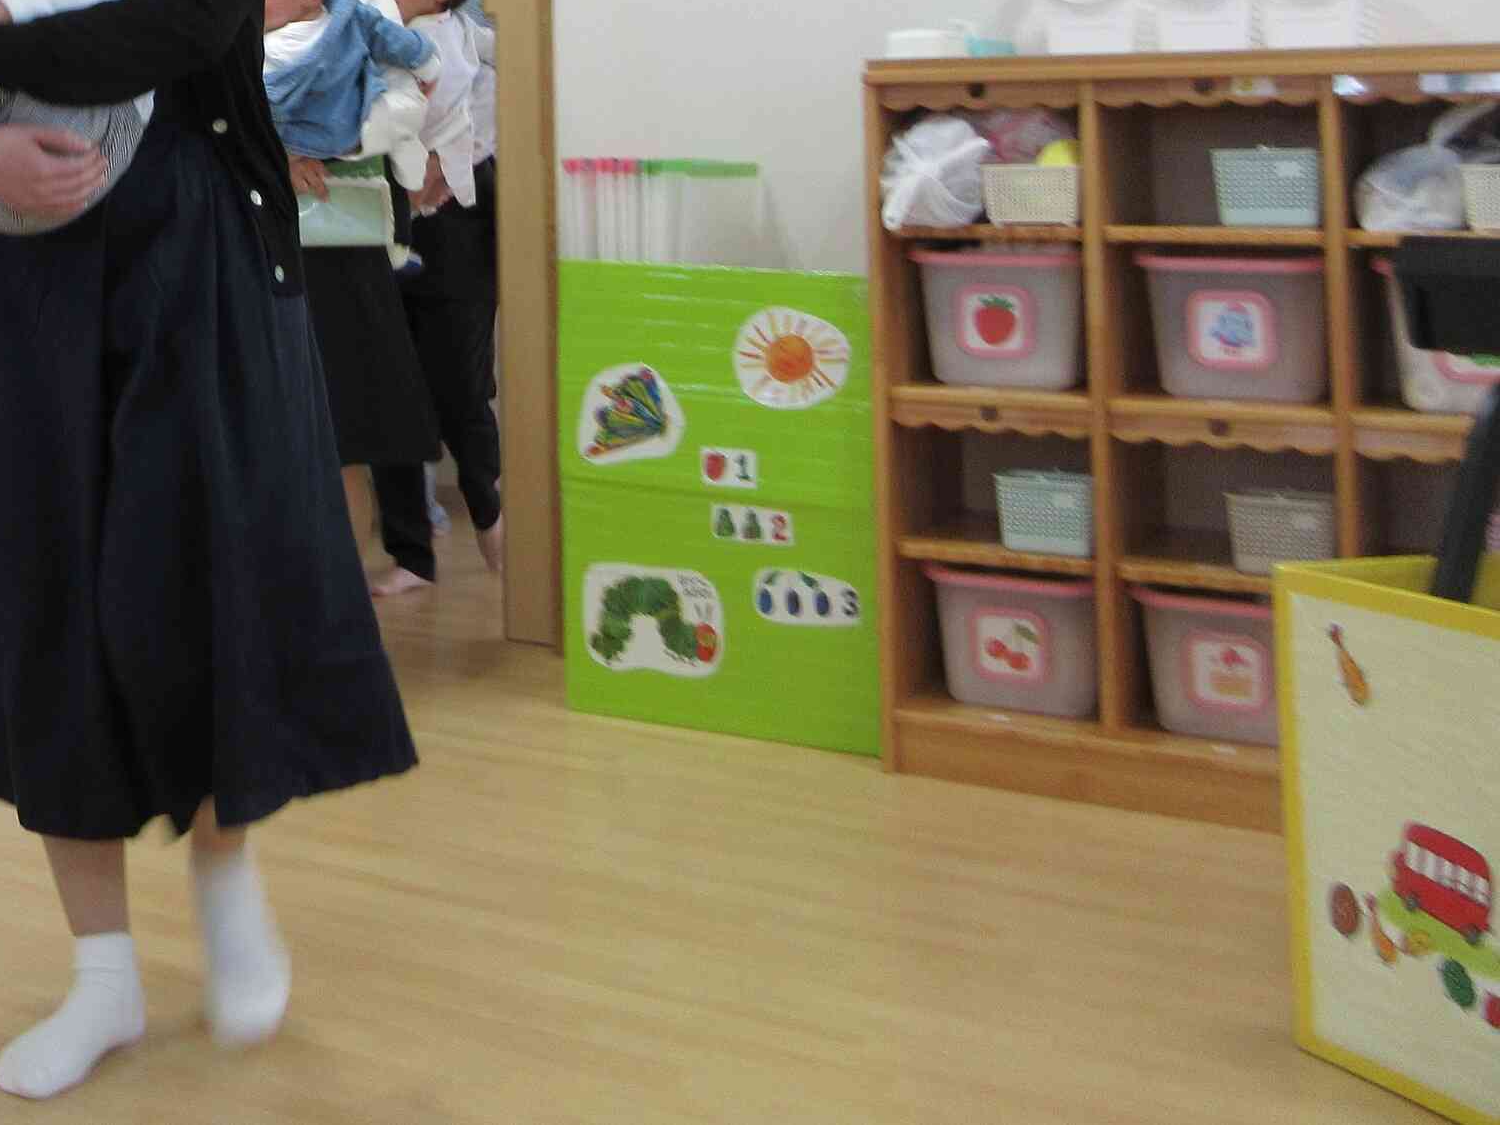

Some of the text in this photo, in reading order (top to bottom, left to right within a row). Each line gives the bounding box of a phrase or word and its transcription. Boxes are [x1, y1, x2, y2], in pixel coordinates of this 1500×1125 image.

[734, 454, 751, 482] 1
[771, 513, 788, 541] 2
[841, 588, 859, 617] 3
